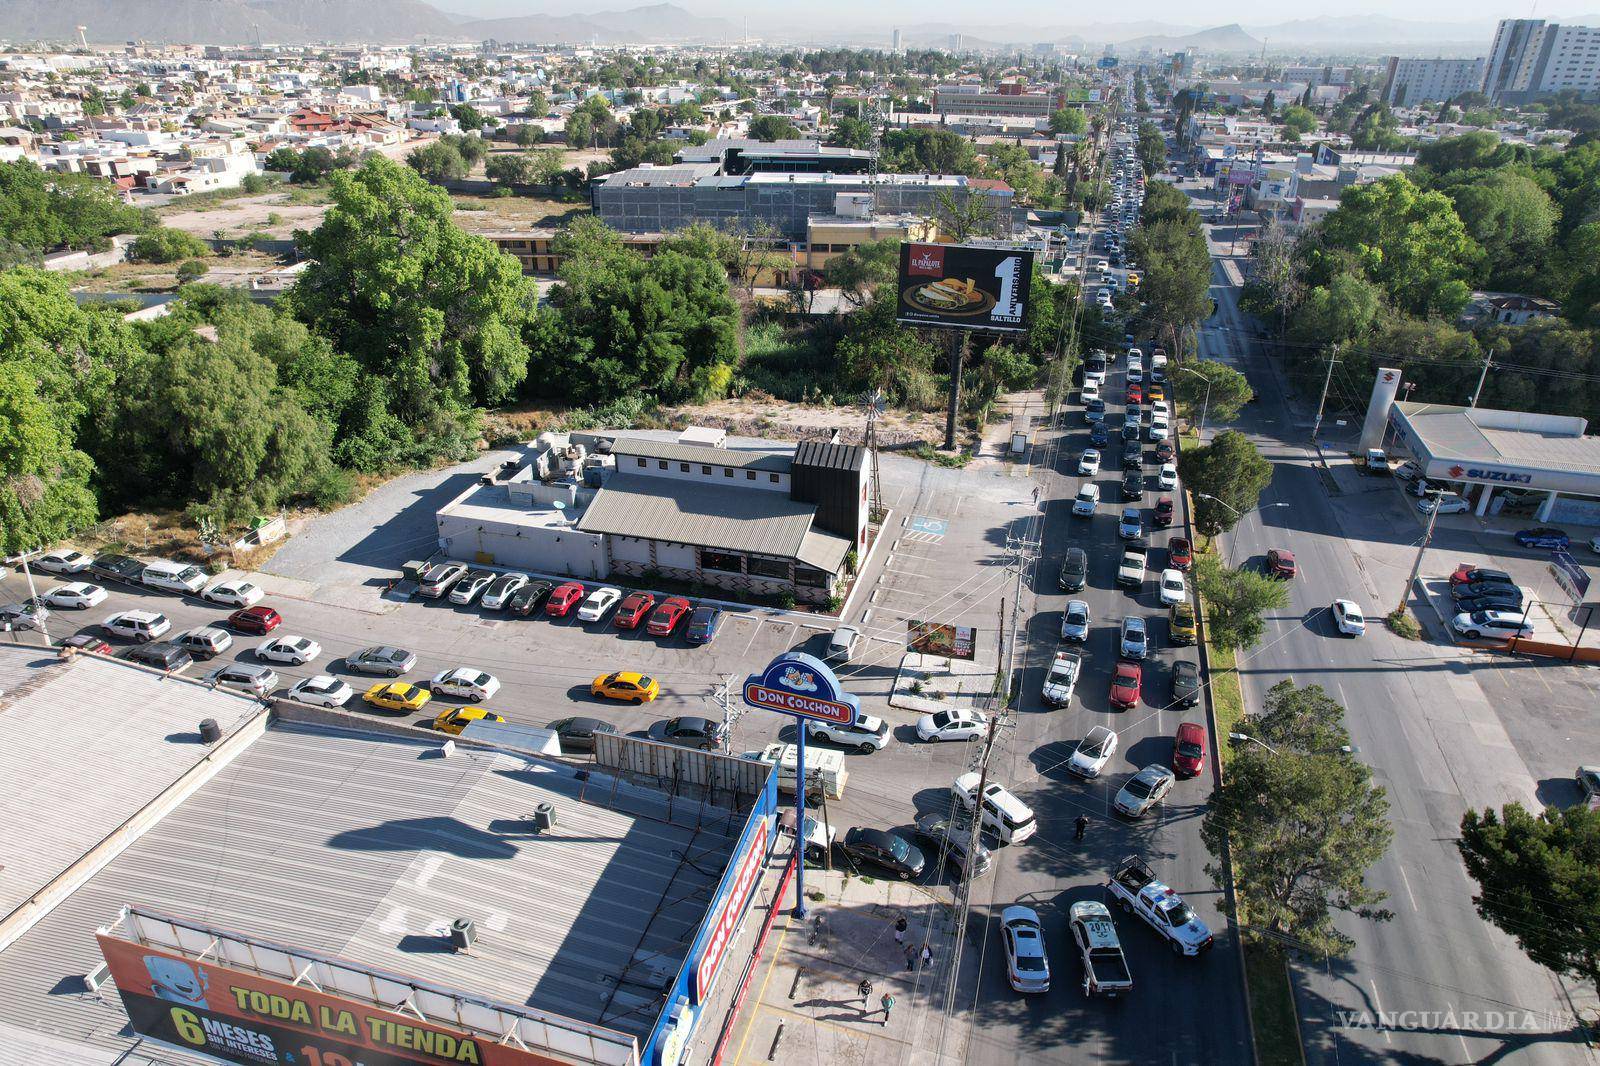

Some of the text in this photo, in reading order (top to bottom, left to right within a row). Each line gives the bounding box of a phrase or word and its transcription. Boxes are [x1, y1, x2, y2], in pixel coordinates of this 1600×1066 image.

[991, 257, 1022, 316] 1
[1009, 257, 1022, 316] ANIVERSARIO
[991, 315, 1021, 323] SALTILLO
[1466, 469, 1532, 483] SUZUKI
[758, 689, 840, 717] DON COLCHON
[170, 1006, 275, 1052] 6 MESES
[230, 986, 479, 1065] TODA LA TIENDA
[207, 1033, 225, 1046] SIN
[226, 1039, 278, 1061] INTERESES
